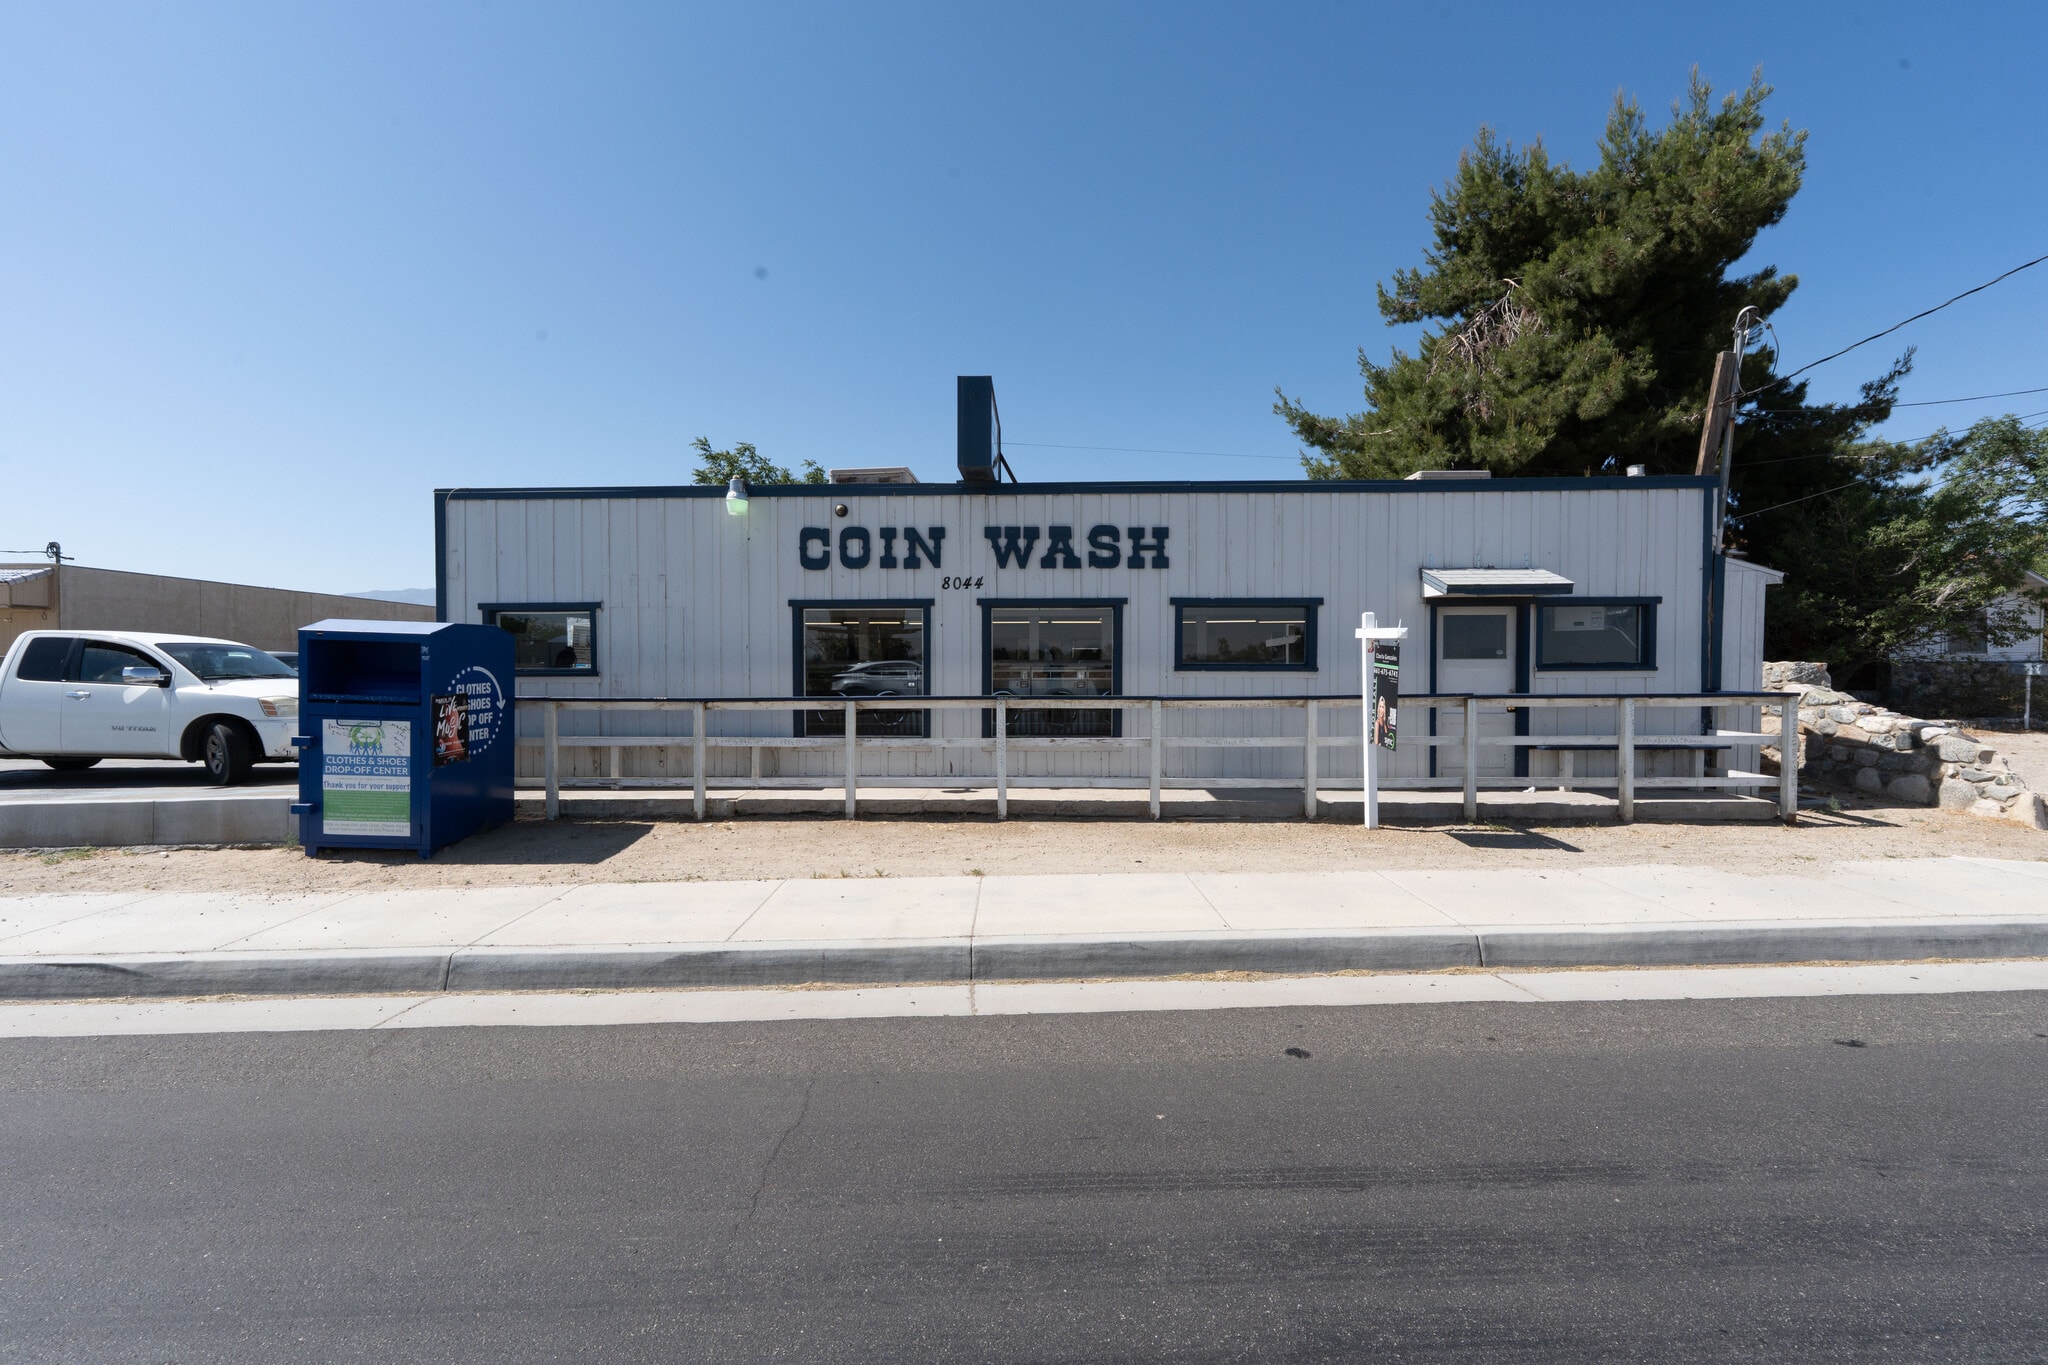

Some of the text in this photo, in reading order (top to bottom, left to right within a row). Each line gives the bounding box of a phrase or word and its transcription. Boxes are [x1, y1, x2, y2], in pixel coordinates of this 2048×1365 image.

[799, 524, 1170, 570] COIN WASH
[941, 576, 984, 590] 8044
[456, 682, 492, 695] CLOTHES
[478, 712, 493, 725] OFF
[469, 728, 489, 741] NTER
[326, 756, 407, 766] CLOTHES & SHOES
[325, 765, 408, 775] DROP-OFF CENTER
[386, 783, 410, 791] support
